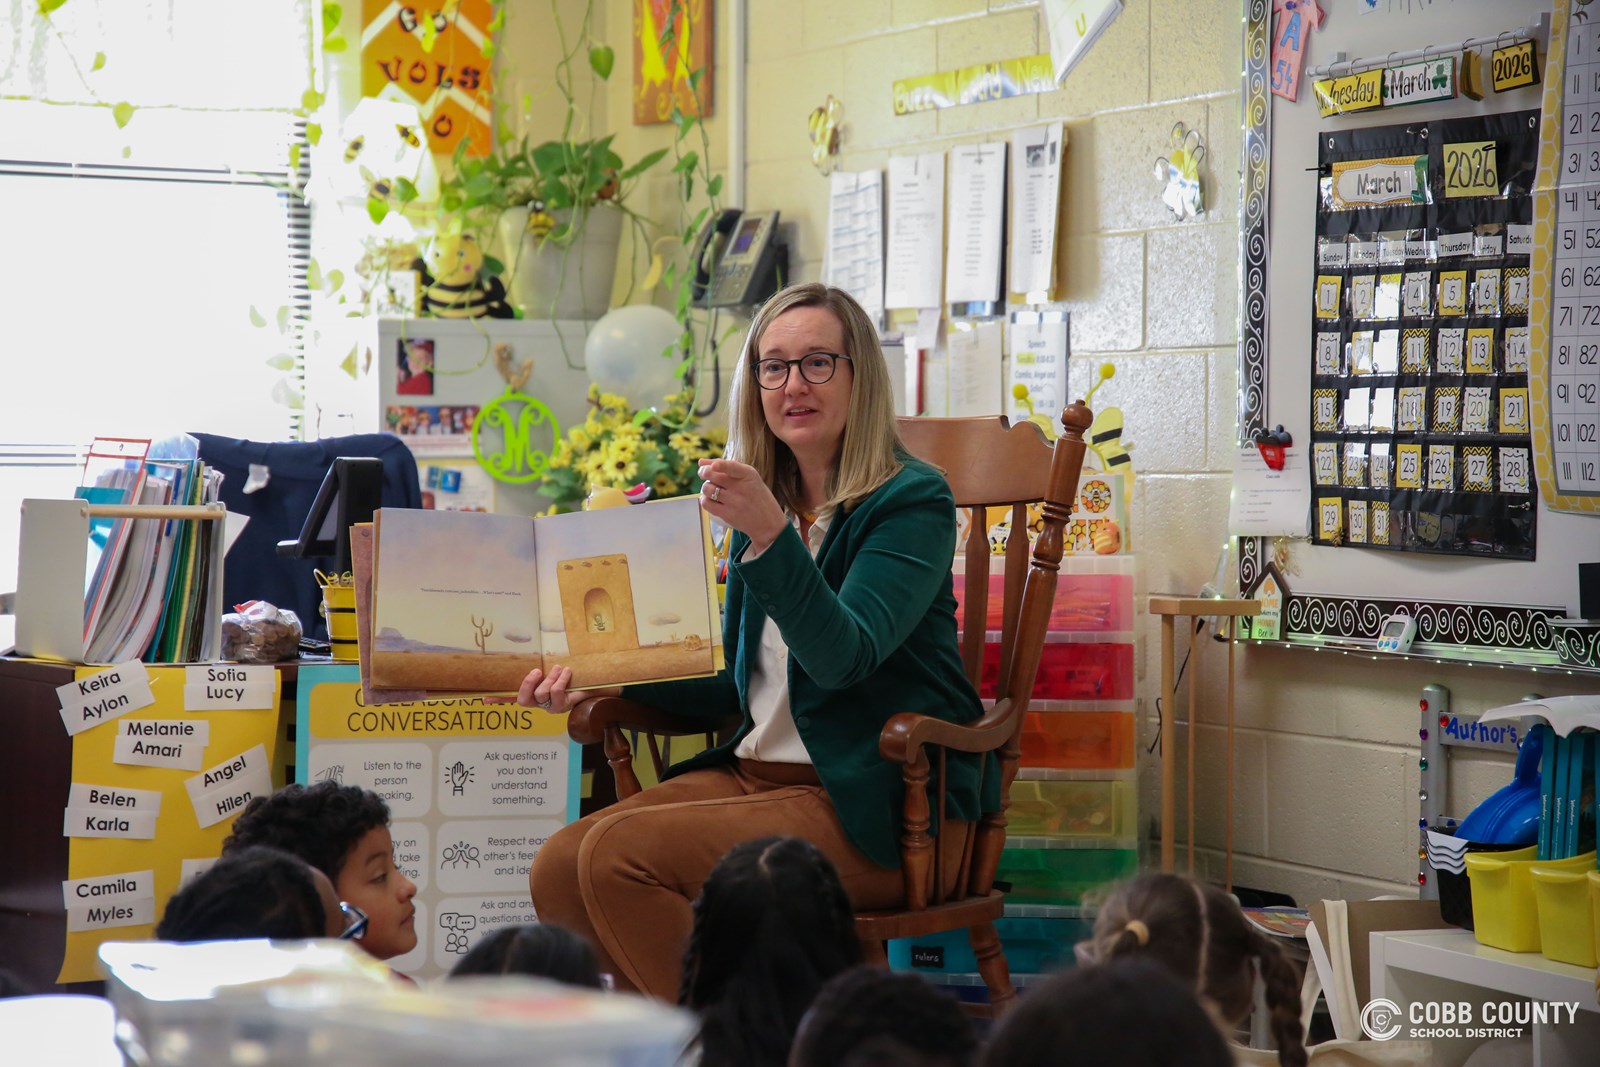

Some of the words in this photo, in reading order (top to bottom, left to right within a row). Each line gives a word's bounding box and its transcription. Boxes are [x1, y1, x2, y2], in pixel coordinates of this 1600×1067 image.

[1493, 53, 1531, 82] 2026
[1390, 67, 1432, 99] March
[1569, 113, 1582, 135] 21
[1568, 153, 1581, 173] 31
[1357, 173, 1402, 195] March
[1447, 148, 1497, 189] 2026
[1565, 193, 1578, 212] 41
[1441, 242, 1471, 252] Thursday
[1563, 230, 1576, 250] 51
[1323, 253, 1343, 263] Sunday
[1561, 267, 1574, 287] 61
[1583, 266, 1600, 286] 62
[1413, 288, 1419, 302] 4
[1449, 286, 1456, 300] 5
[1484, 284, 1490, 299] 6
[1515, 283, 1521, 298] 7
[1559, 306, 1572, 326] 71
[1582, 305, 1600, 326] 72
[1325, 346, 1330, 360] 8
[1446, 343, 1456, 358] 12
[1475, 343, 1486, 358] 13
[1513, 342, 1526, 356] 14
[1558, 345, 1570, 365] 81
[1579, 344, 1598, 365] 82
[1557, 384, 1569, 403] 91
[1578, 383, 1596, 403] 92
[1320, 403, 1331, 417] 15
[1441, 402, 1451, 417] 19
[1470, 402, 1483, 416] 20
[1508, 402, 1521, 417] 21
[1557, 424, 1570, 442] 101
[1577, 424, 1596, 442] 102
[1321, 456, 1332, 470] 22
[1348, 457, 1358, 471] 23
[1375, 458, 1384, 471] 24
[1403, 458, 1415, 473] 25
[1435, 459, 1447, 474] 26
[1471, 461, 1485, 475] 27
[1507, 462, 1521, 477] 28
[1562, 462, 1572, 480] 111
[1581, 462, 1595, 481] 112
[1325, 511, 1336, 526] 29
[1353, 513, 1362, 527] 30
[1377, 514, 1384, 529] 31
[208, 668, 247, 683] Sofia
[78, 671, 121, 696] Keira
[206, 685, 244, 702] Lucy
[82, 692, 129, 721] Aylon
[347, 710, 533, 732] CONVERSATIONS
[127, 722, 194, 736] Melanie
[1446, 716, 1518, 743] Author's
[132, 741, 182, 758] Amari
[484, 752, 500, 761] Ask
[503, 752, 549, 763] questions
[551, 751, 557, 760] if
[203, 756, 247, 788] Angel
[363, 761, 391, 771] Listen
[393, 761, 403, 770] to
[405, 760, 422, 770] the
[497, 767, 515, 777] you
[517, 765, 543, 775] don't
[374, 776, 408, 787] person
[491, 780, 547, 790] understand
[89, 790, 137, 808] Belen
[216, 790, 252, 816] Hilen
[377, 790, 414, 802] eaking.
[492, 795, 546, 806] something.
[85, 817, 130, 832] Karla
[404, 840, 417, 848] on
[488, 837, 527, 848] Respect
[528, 838, 549, 846] eac
[399, 853, 421, 862] take
[484, 851, 516, 861] other's
[494, 866, 514, 875] and
[76, 878, 137, 898] Camila
[481, 901, 495, 909] Ask
[497, 900, 516, 909] and
[87, 906, 134, 923] Myles
[479, 914, 521, 925] questions
[915, 953, 939, 963] rulers
